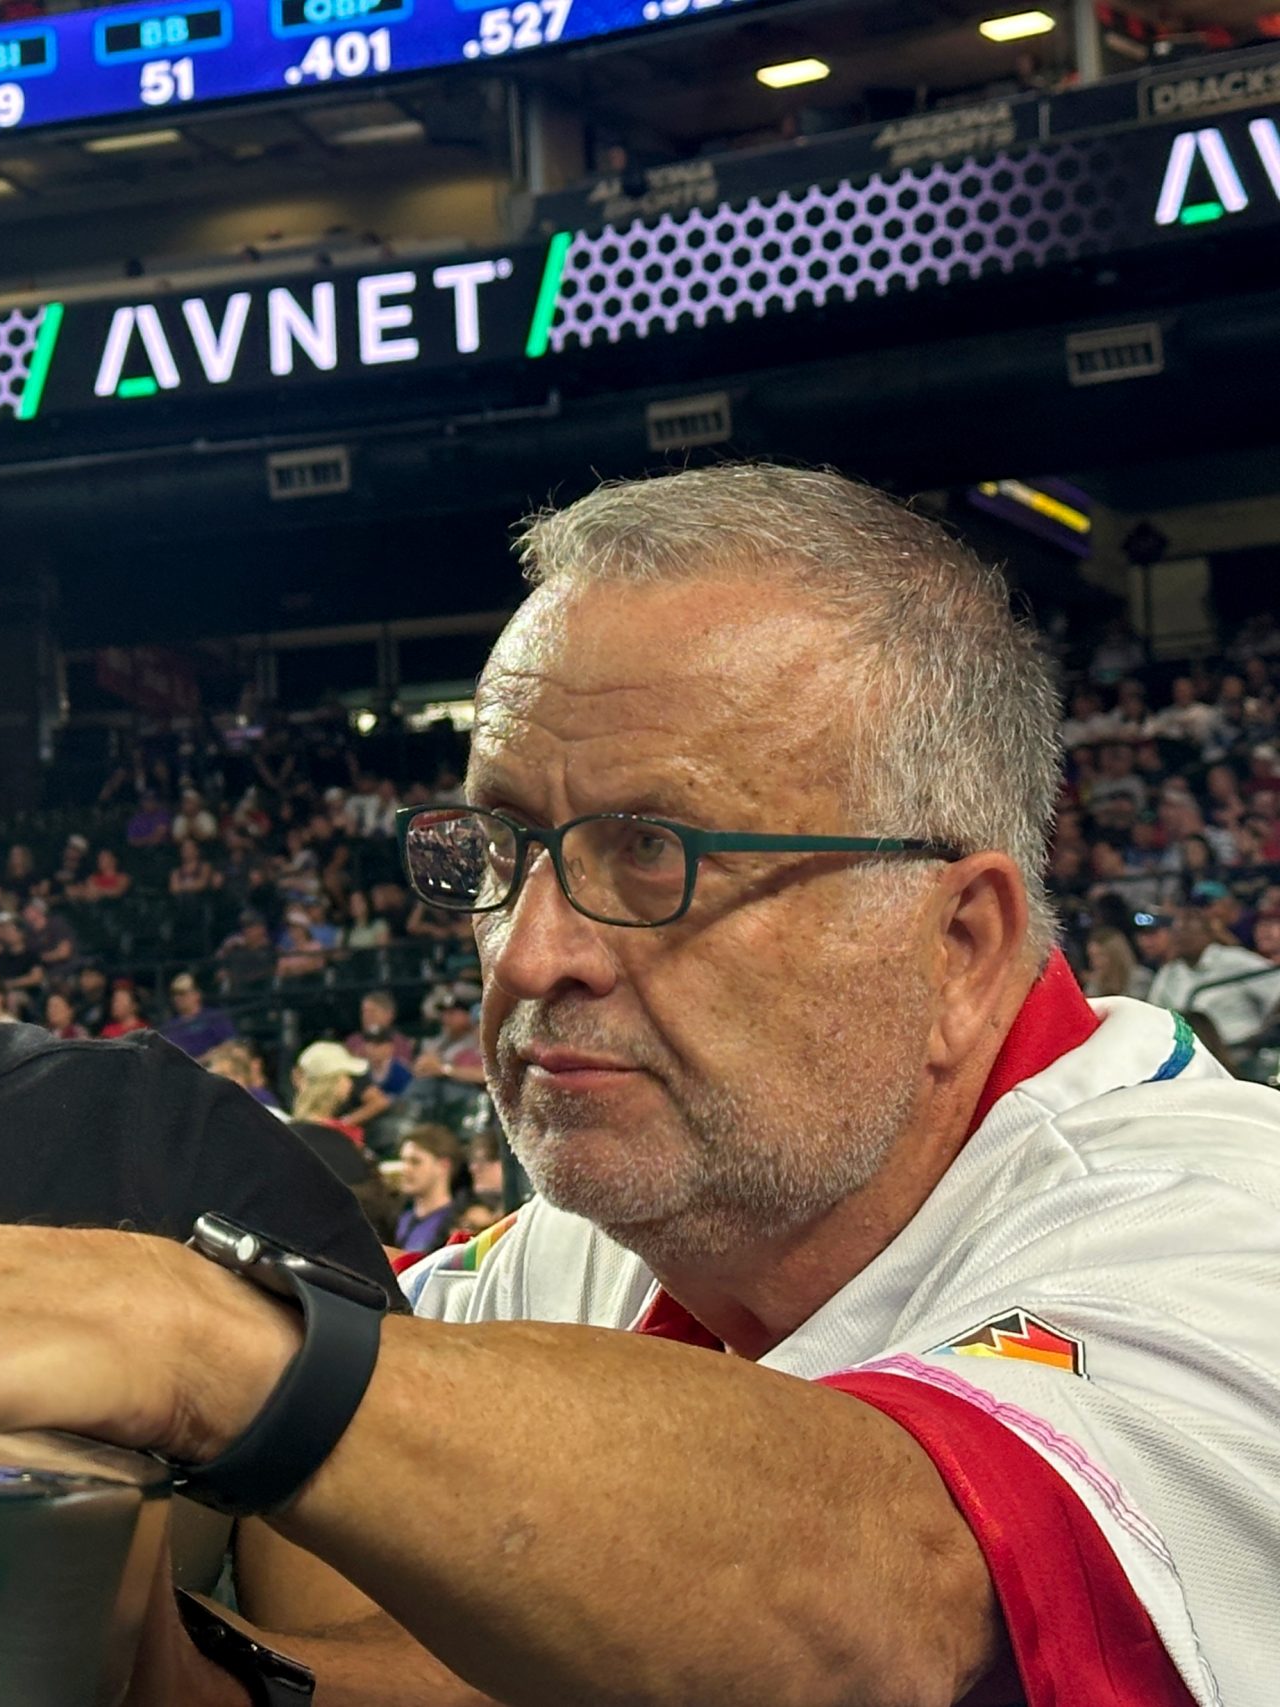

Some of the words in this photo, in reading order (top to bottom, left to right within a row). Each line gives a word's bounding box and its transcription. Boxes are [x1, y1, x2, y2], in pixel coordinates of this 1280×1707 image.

[140, 15, 189, 48] BB
[140, 56, 194, 105] 51
[284, 27, 391, 85] .401
[463, 0, 573, 59] .527
[94, 260, 497, 398] AVNET
